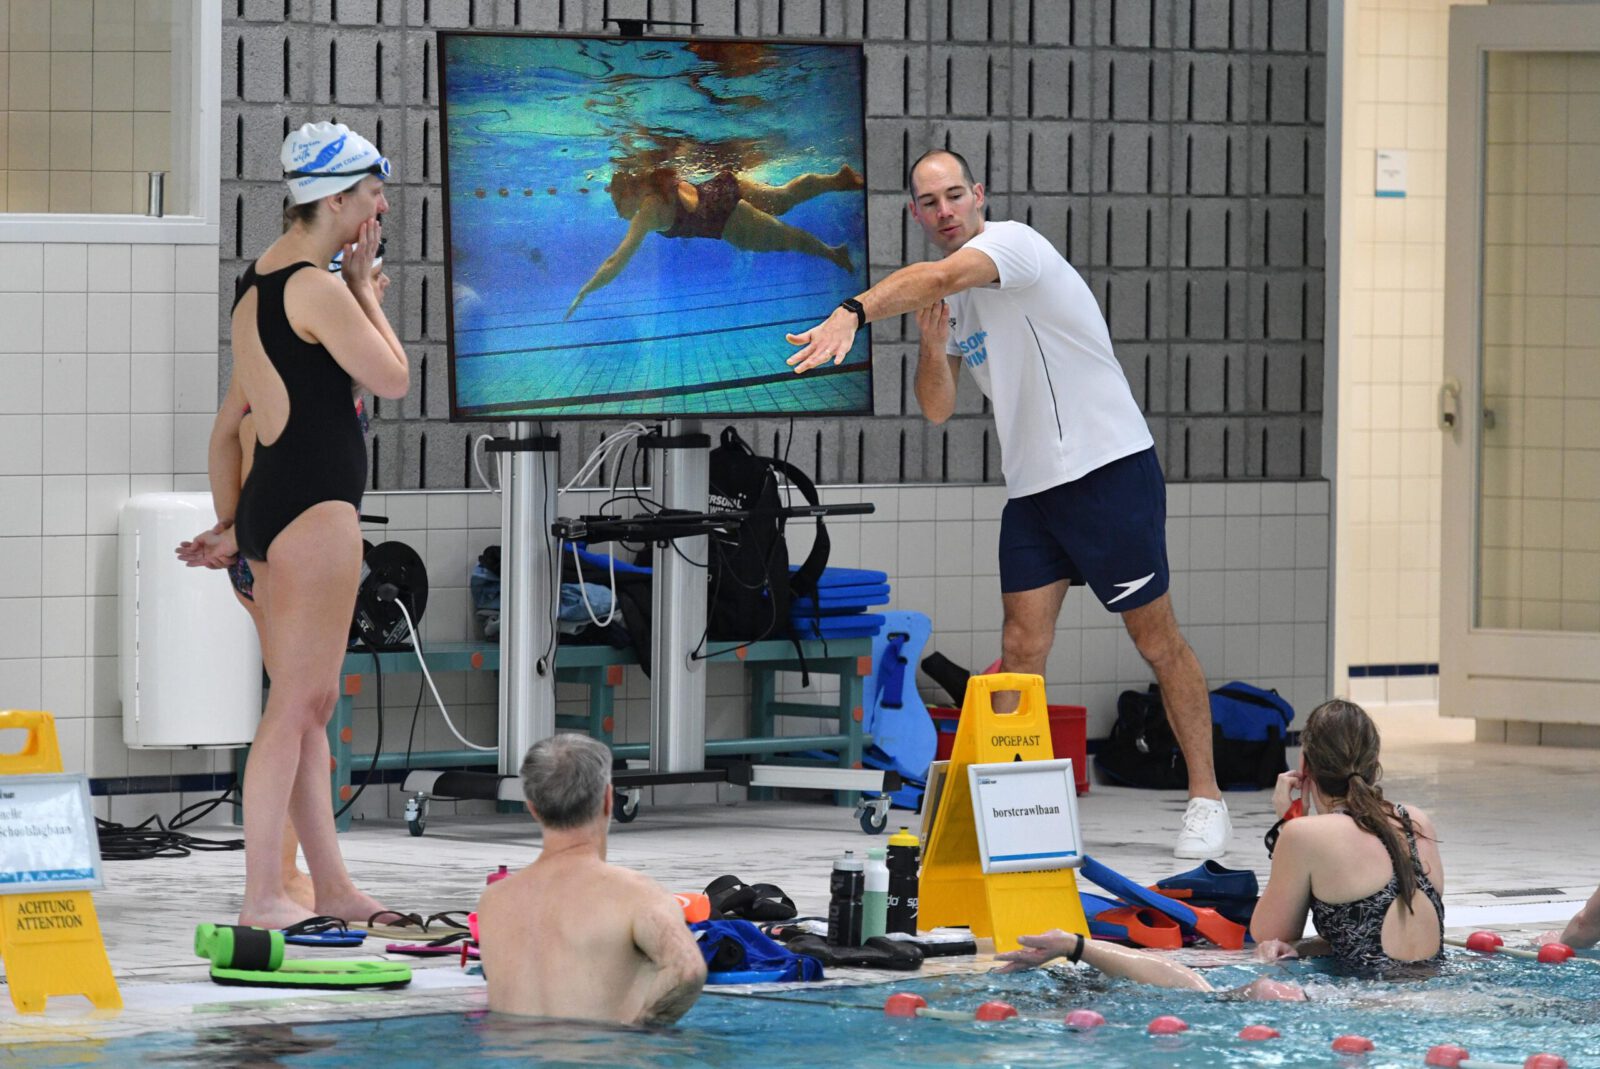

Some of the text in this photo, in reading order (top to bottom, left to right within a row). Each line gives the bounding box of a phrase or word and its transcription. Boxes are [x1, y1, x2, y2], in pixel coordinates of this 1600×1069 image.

[991, 735, 1041, 747] OPGEPAST
[992, 804, 1060, 818] borstcrawlbaan
[17, 899, 76, 915] ACHTUNG
[16, 914, 83, 931] ATTENTION
